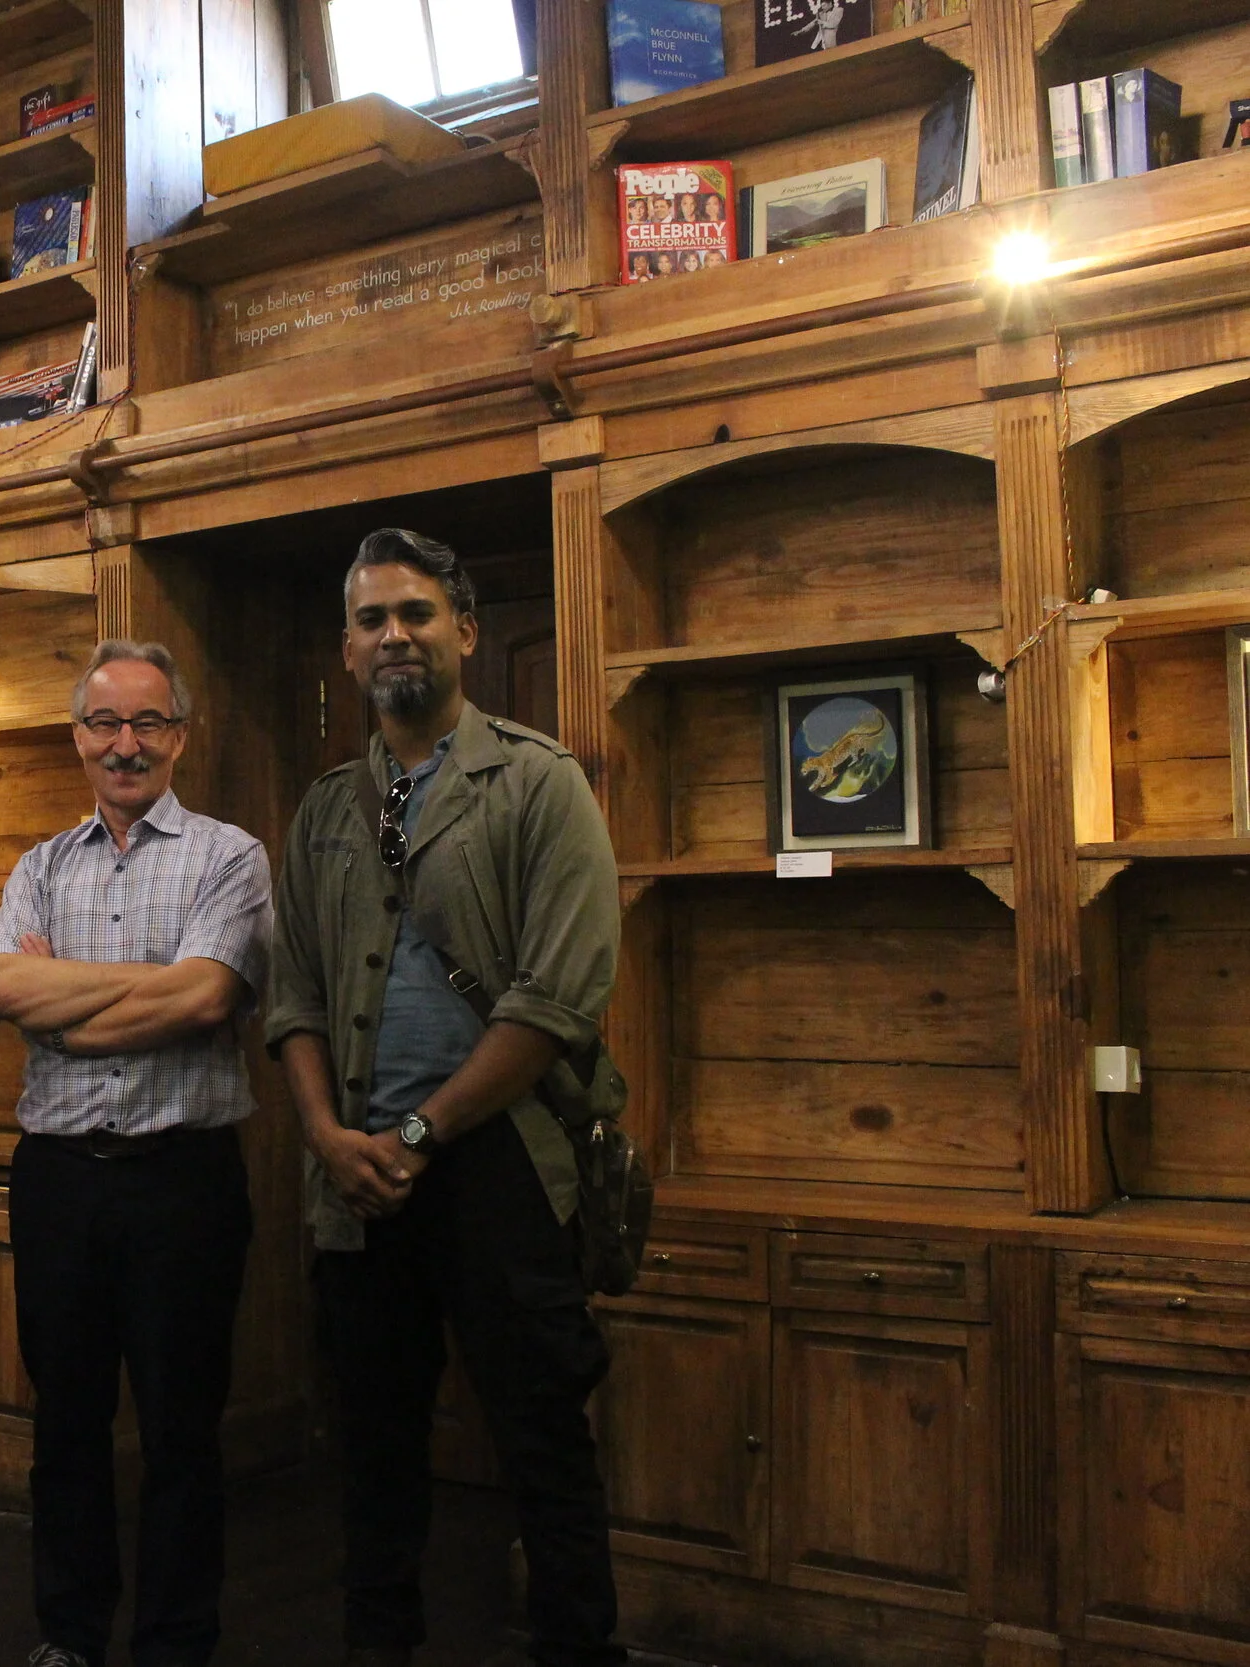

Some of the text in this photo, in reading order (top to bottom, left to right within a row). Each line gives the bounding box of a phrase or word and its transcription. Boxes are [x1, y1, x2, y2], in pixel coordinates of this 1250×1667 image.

[764, 0, 858, 28] ELV
[650, 27, 710, 43] McCONNELL
[651, 39, 677, 51] BRUE
[652, 51, 683, 63] FLYNN
[624, 167, 700, 200] People
[626, 221, 727, 240] CELEBRITY
[626, 236, 727, 248] TRANSFORMATIONS
[246, 299, 264, 317] do
[267, 289, 316, 311] believe
[325, 268, 401, 298] something
[408, 257, 446, 276] very
[455, 233, 522, 266] magical
[235, 255, 546, 347] happen when you read a good book
